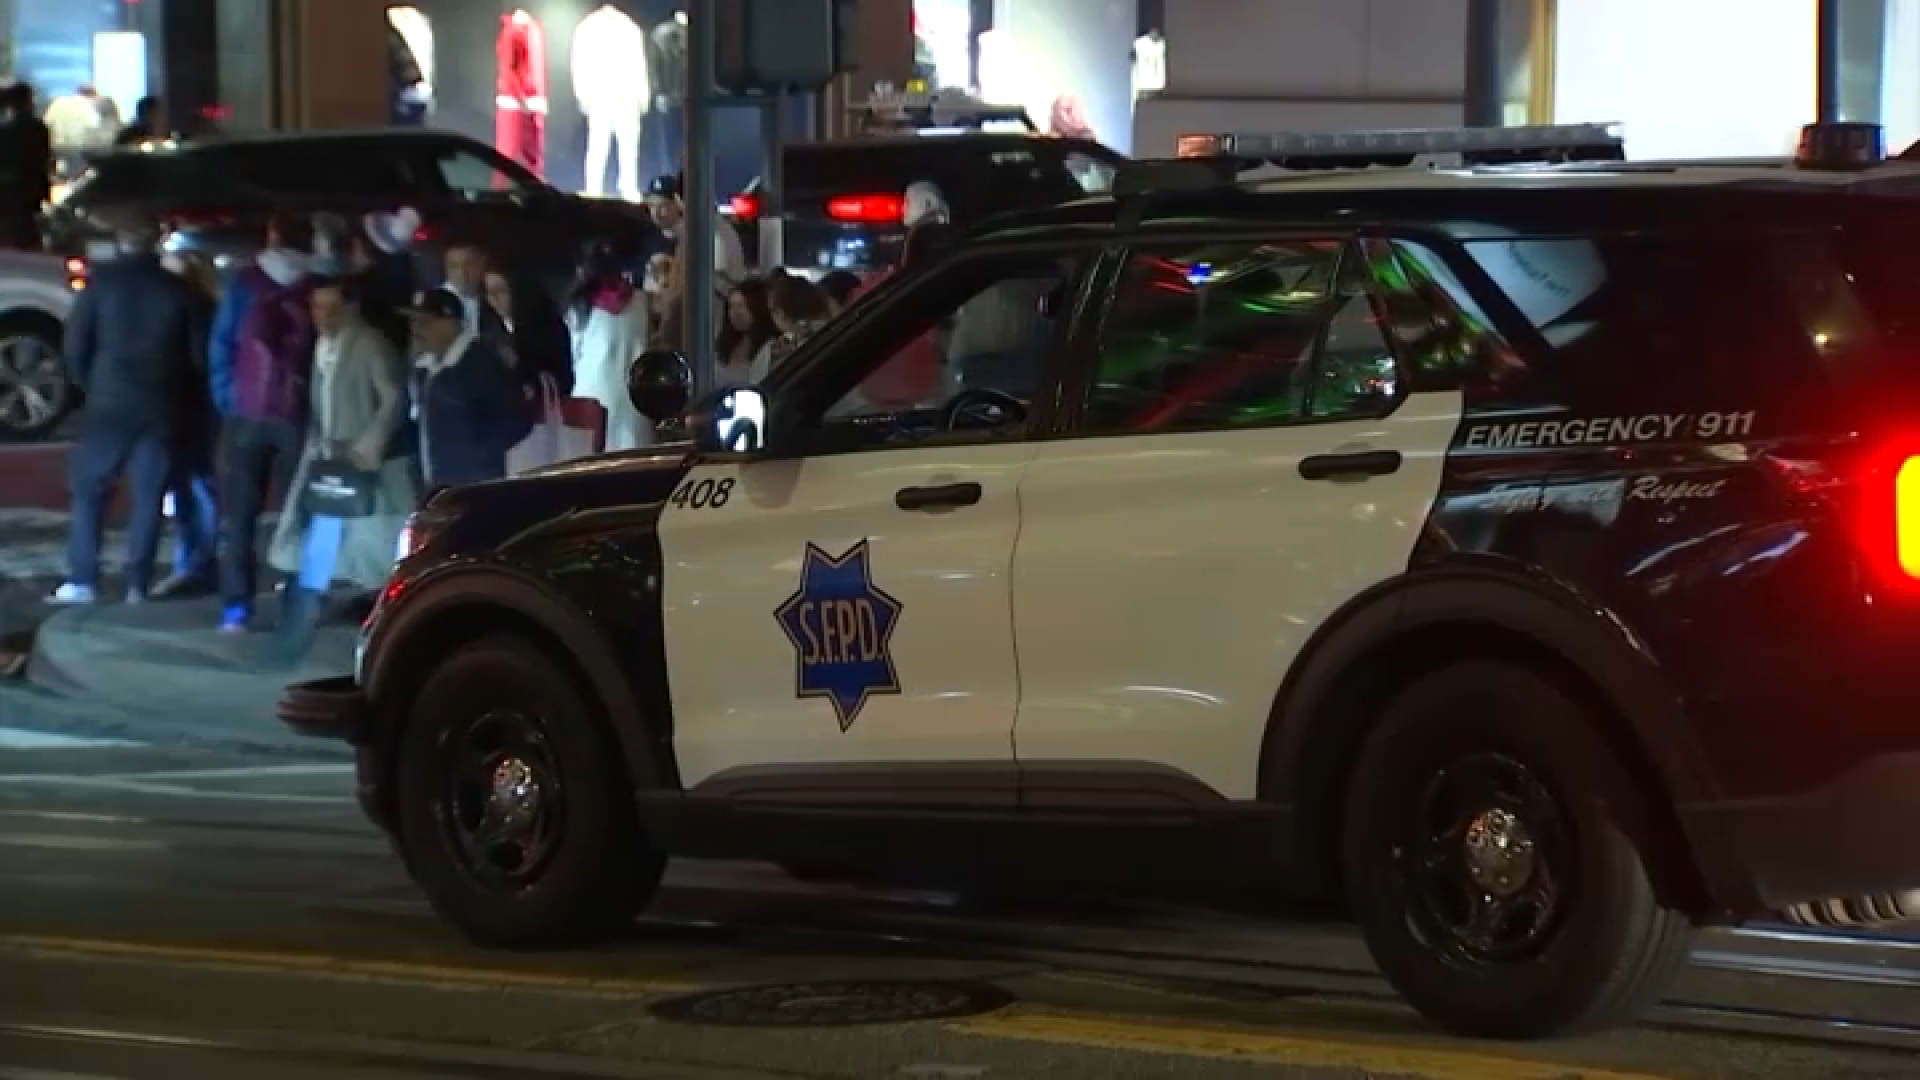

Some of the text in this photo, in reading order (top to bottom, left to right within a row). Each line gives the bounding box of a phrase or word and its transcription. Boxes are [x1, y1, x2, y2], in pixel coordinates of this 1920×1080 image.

[1466, 415, 1685, 449] EMERGENCY
[1696, 410, 1756, 438] 911
[672, 477, 736, 510] 408
[1628, 475, 1728, 504] Respect
